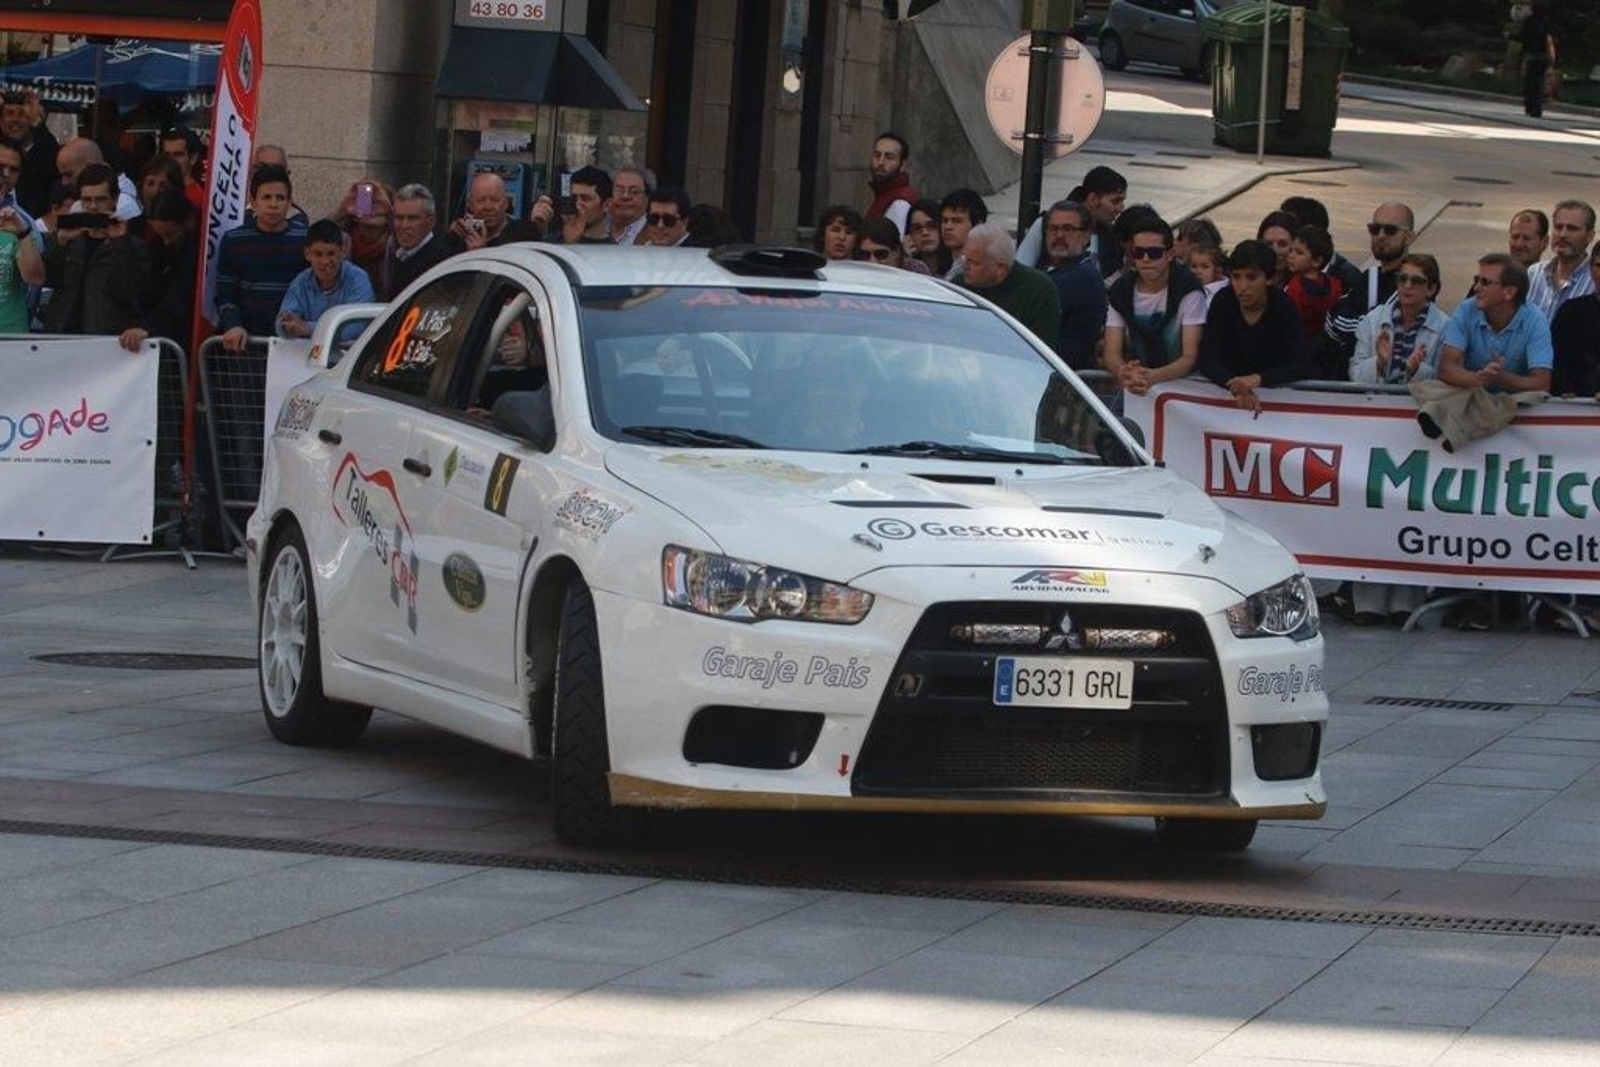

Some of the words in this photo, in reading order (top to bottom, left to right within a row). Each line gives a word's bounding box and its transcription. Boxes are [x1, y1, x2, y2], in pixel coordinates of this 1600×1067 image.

[472, 2, 492, 16] 43
[497, 3, 518, 17] 80
[523, 4, 543, 18] 36
[383, 305, 421, 373] 8
[491, 458, 512, 512] 8
[1210, 438, 1335, 500] MC
[345, 467, 389, 565] Talleres
[920, 522, 1091, 541] Gescomar
[1397, 526, 1512, 564] Grupo
[702, 645, 799, 690] Garaje
[1015, 668, 1075, 697] 6331
[1085, 671, 1129, 699] GRL
[1237, 663, 1304, 702] Garaje
